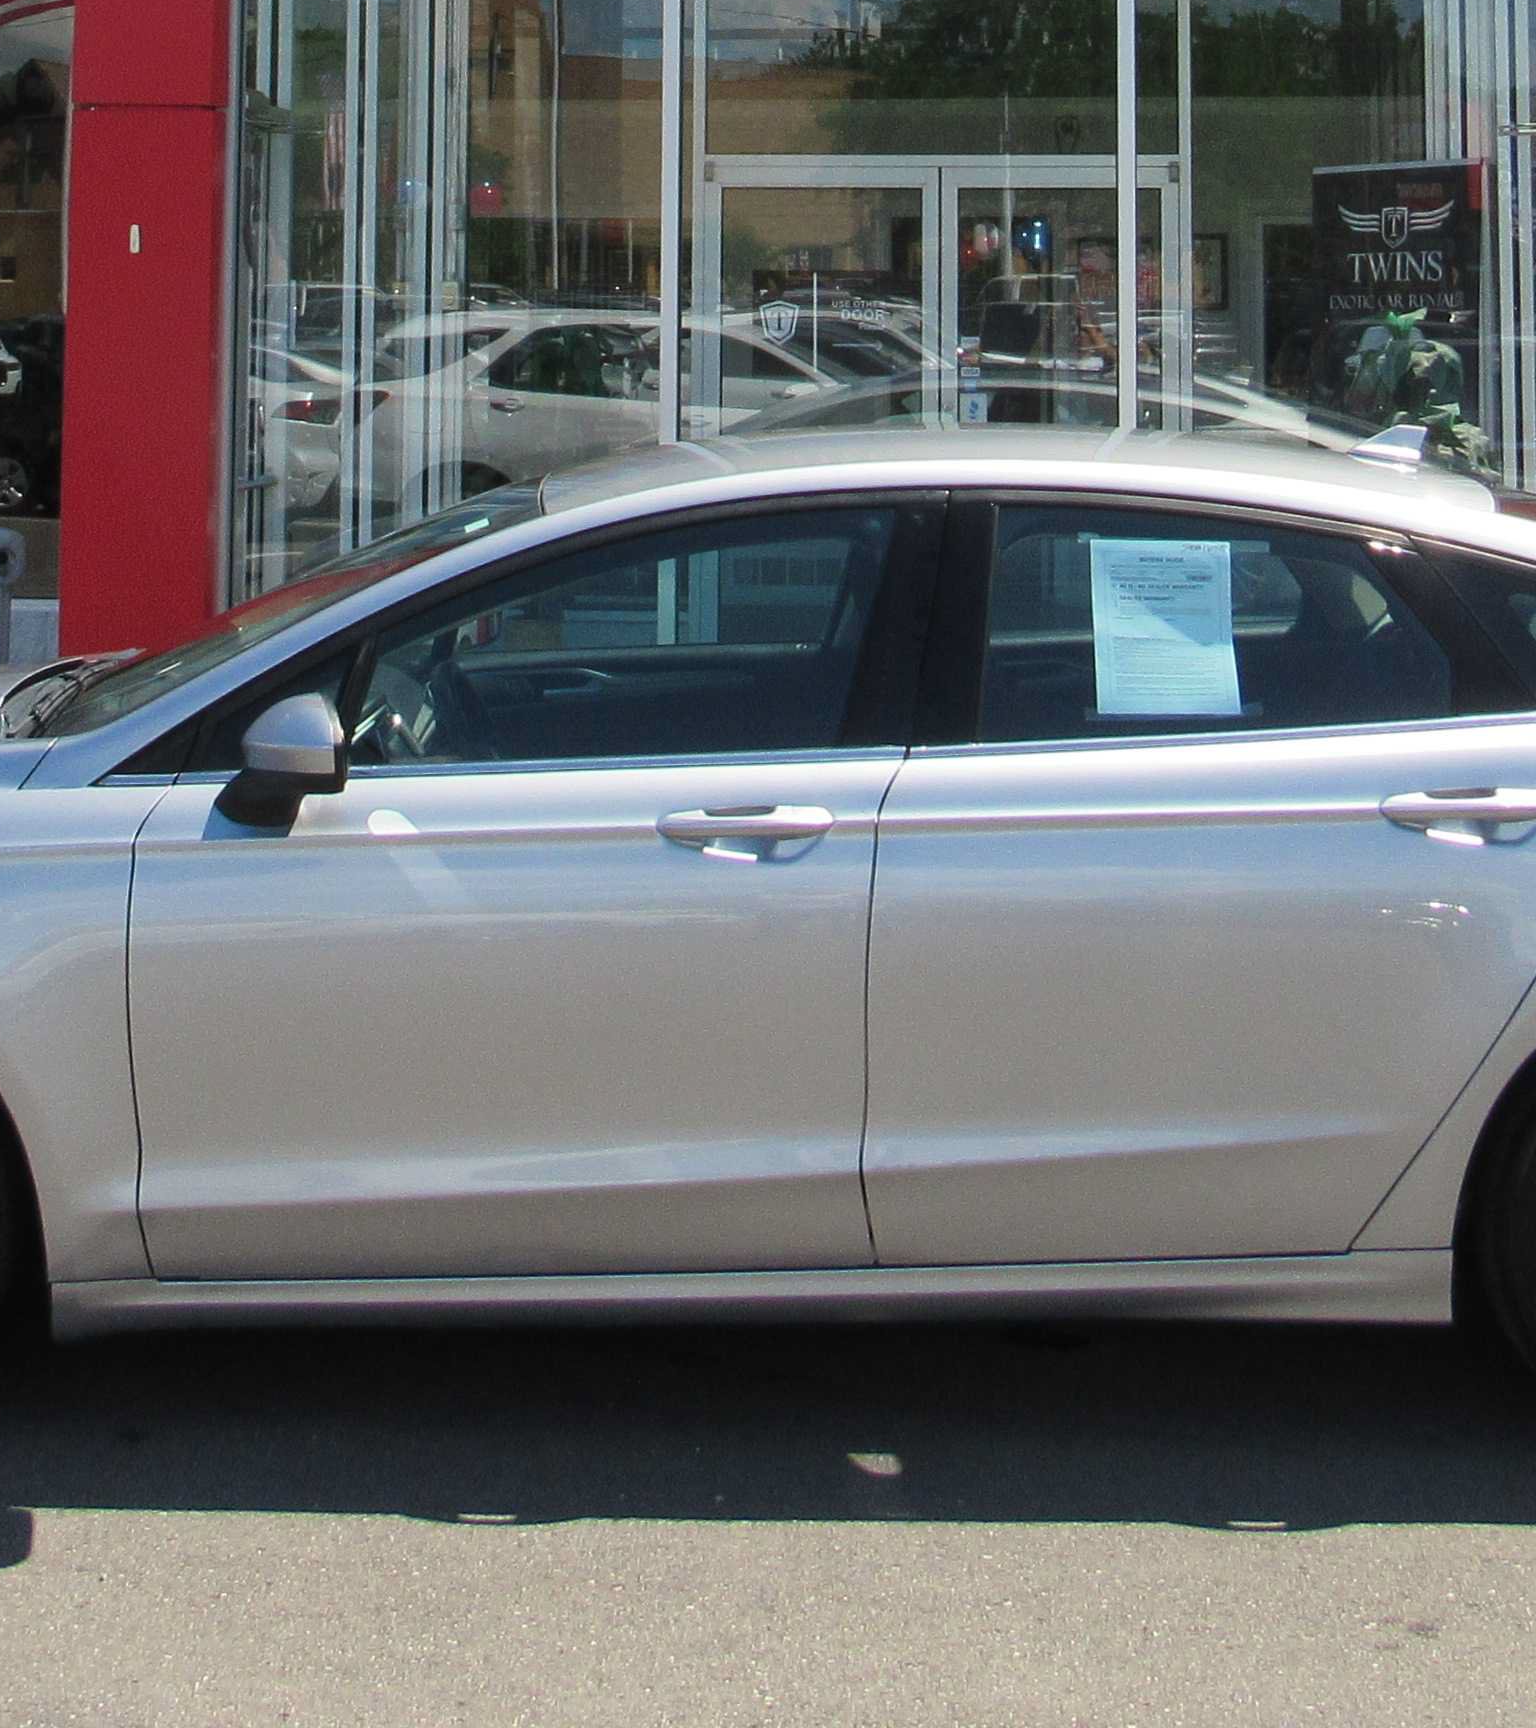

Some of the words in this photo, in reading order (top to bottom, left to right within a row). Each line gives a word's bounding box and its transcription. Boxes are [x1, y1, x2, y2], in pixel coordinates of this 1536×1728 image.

[1344, 251, 1443, 283] TWINS
[1377, 293, 1405, 308] CAR
[840, 309, 885, 321] DOOR
